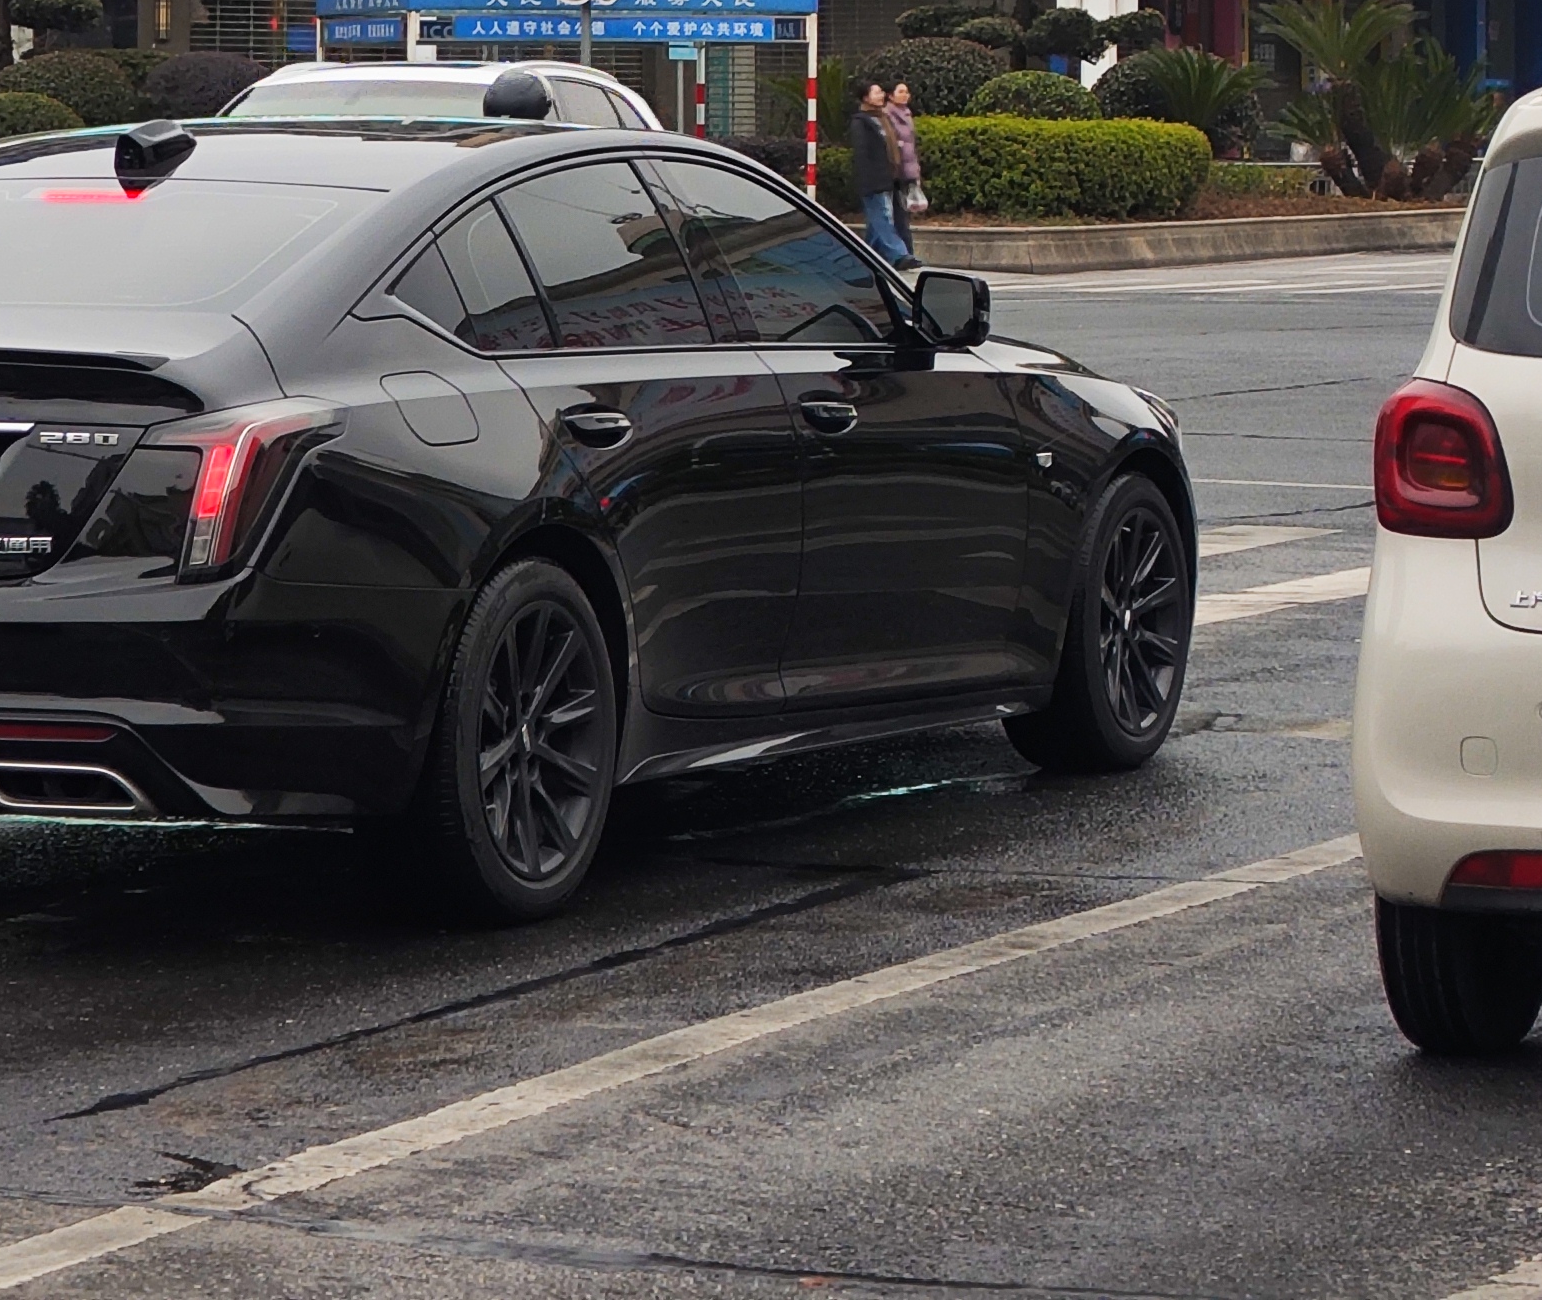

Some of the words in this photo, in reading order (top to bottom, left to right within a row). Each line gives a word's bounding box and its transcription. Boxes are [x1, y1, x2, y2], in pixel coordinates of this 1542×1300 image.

[633, 21, 765, 38] 个个爱护公共环境
